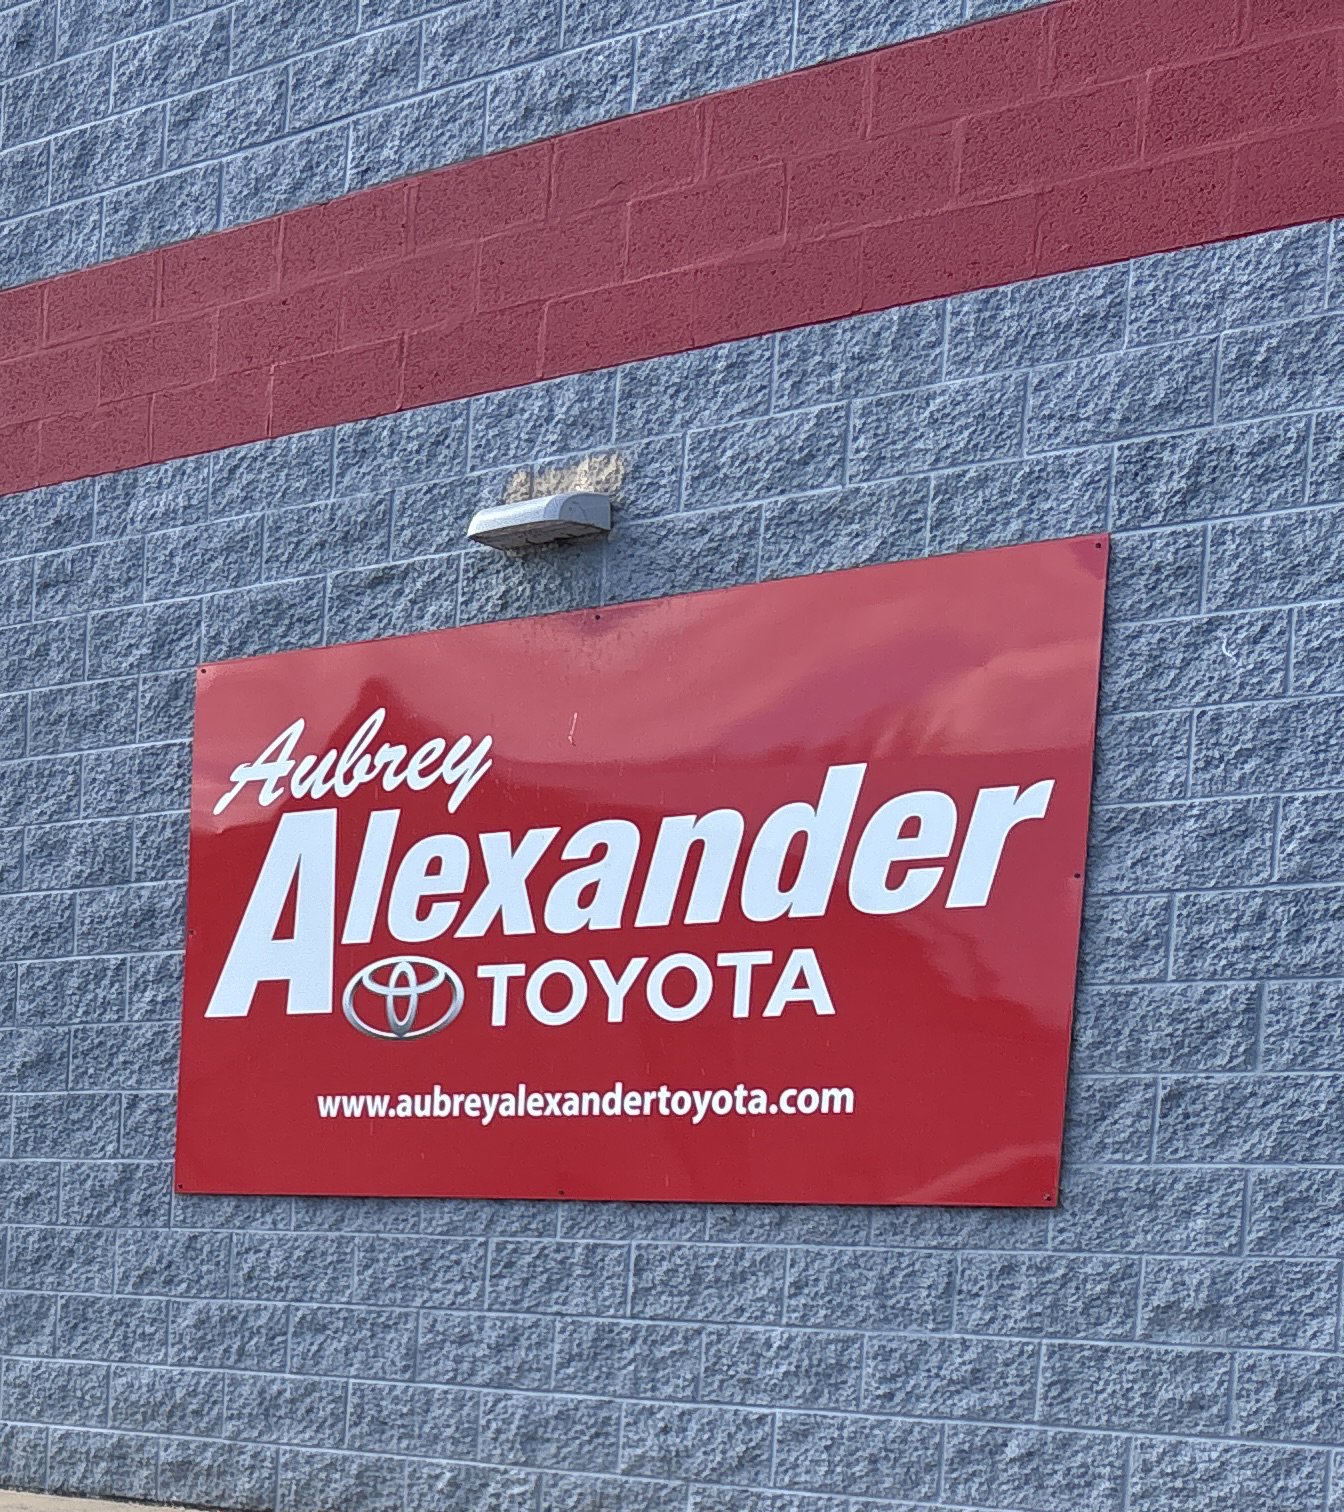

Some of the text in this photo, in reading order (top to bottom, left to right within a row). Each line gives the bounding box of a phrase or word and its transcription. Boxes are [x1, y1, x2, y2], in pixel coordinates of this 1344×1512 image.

[212, 707, 493, 816] Aubrey
[204, 762, 1057, 1018] Alexander
[477, 948, 836, 1027] TOYOTA
[317, 1081, 855, 1126] www.aubreyalexandertoyota.com
